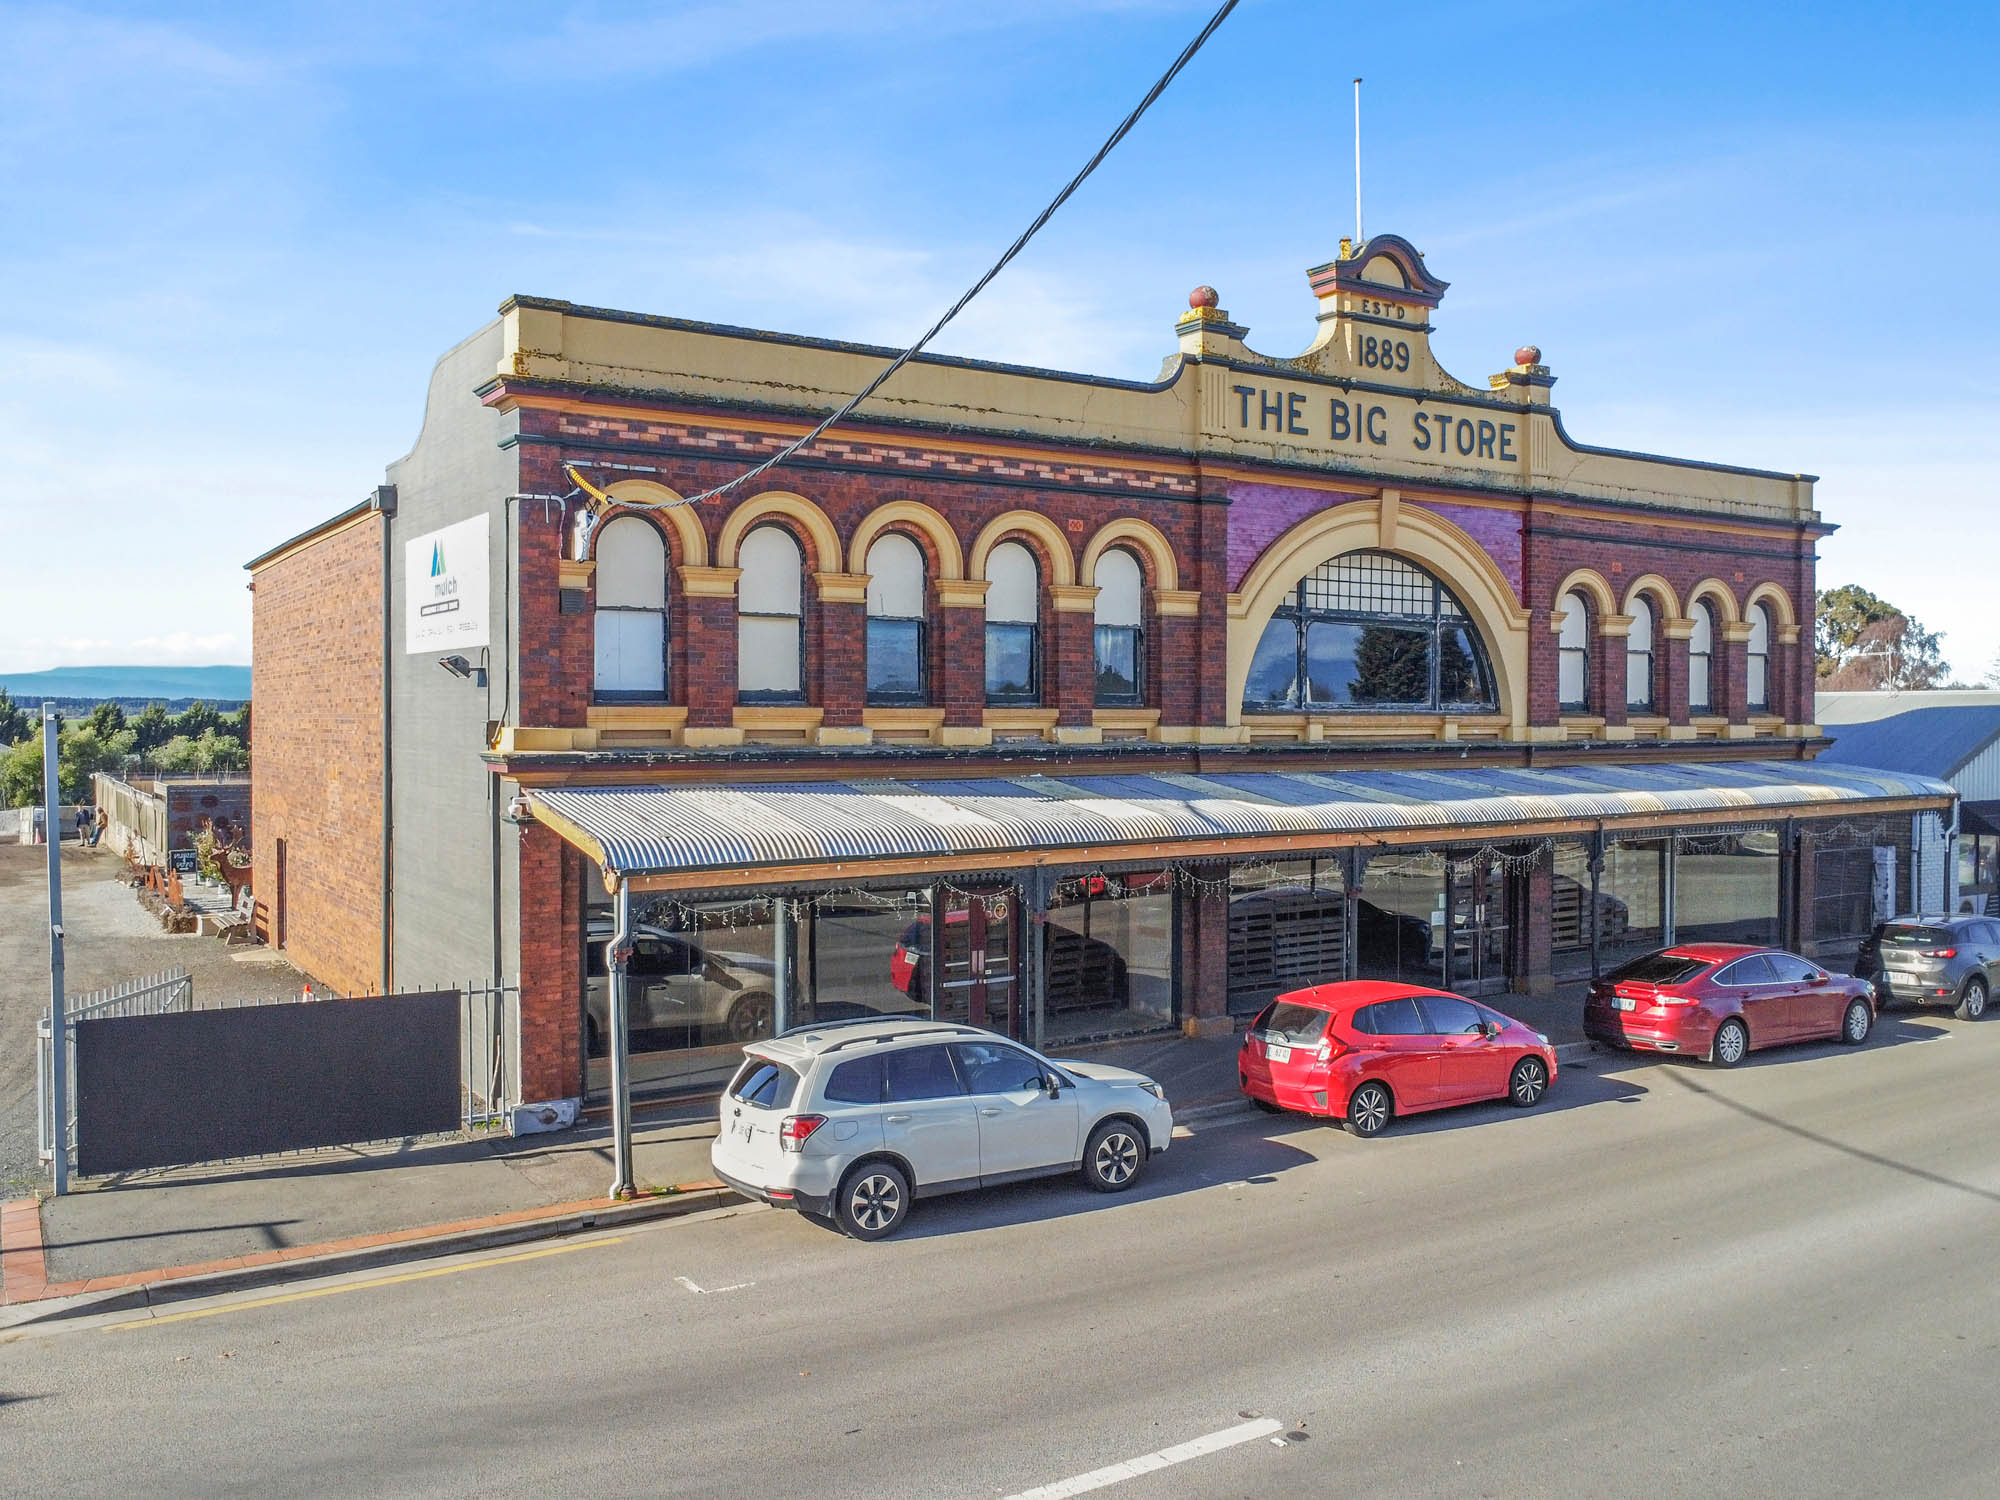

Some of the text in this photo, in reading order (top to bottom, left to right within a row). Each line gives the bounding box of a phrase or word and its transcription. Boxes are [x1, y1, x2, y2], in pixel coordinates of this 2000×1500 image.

[1362, 299, 1405, 319] EST'D
[1358, 334, 1410, 372] 1889
[1234, 385, 1518, 462] THE BIG STORE
